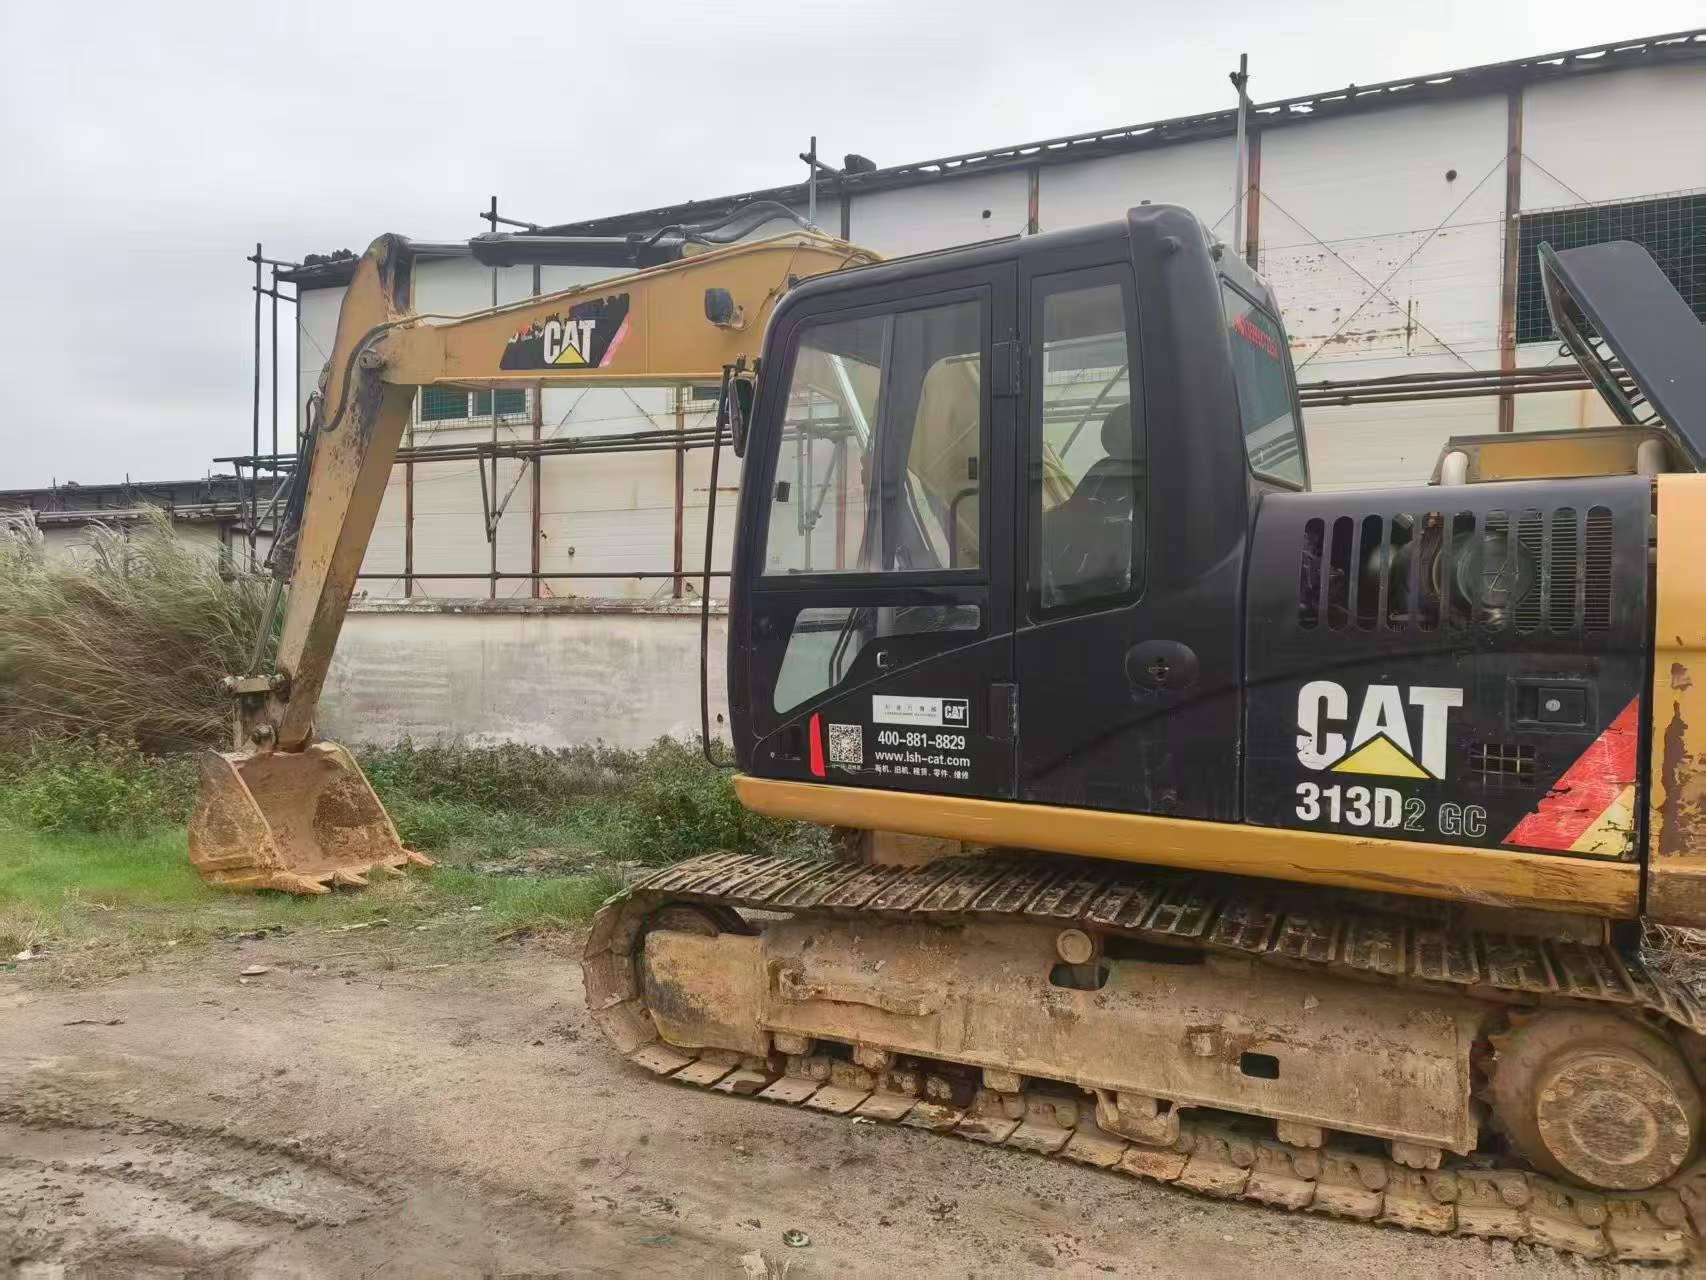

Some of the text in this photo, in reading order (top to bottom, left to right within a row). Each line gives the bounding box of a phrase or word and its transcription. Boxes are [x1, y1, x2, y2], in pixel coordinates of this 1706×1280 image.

[544, 320, 596, 364] CAT
[944, 705, 966, 720] CAT
[878, 730, 966, 750] 400-881-8829
[1297, 681, 1463, 780] CAT
[875, 751, 970, 767] www.lsh-cat.com
[1439, 802, 1487, 837] GC
